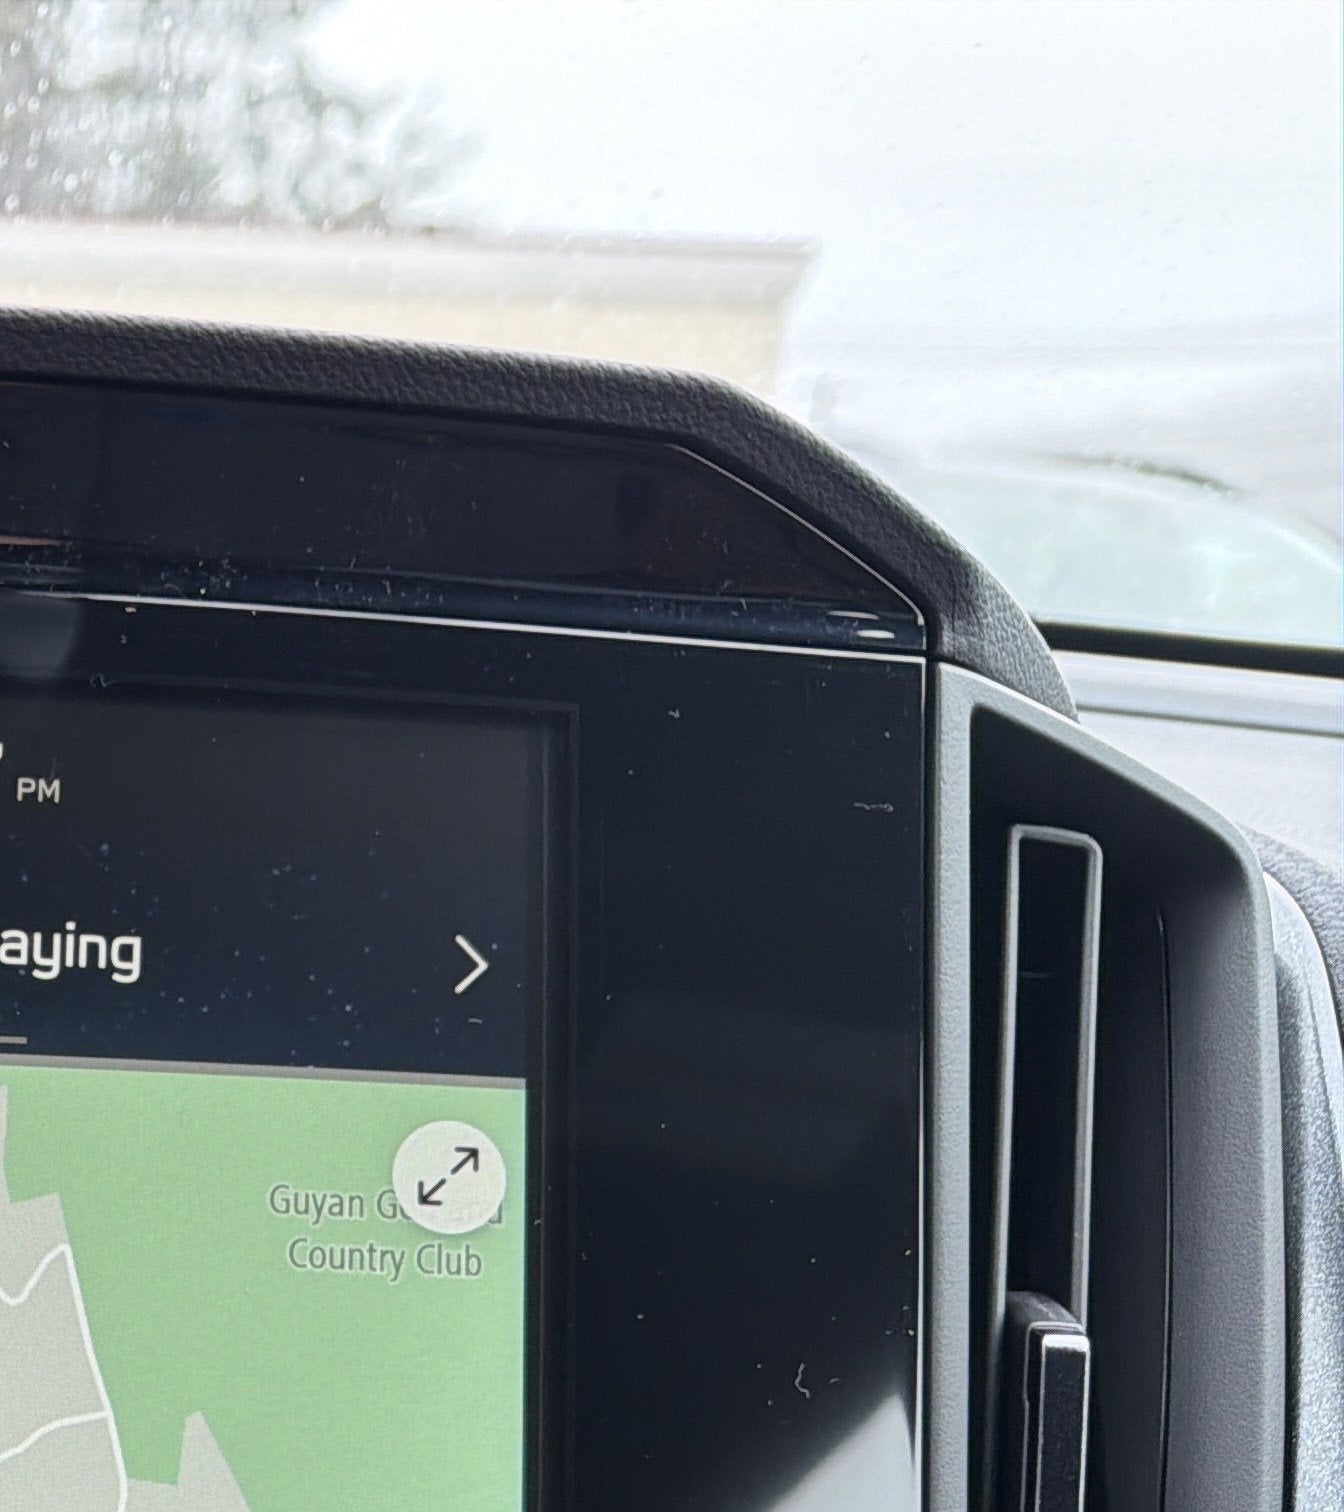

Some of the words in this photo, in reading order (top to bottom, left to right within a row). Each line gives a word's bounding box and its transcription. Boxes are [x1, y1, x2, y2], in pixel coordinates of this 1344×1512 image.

[17, 776, 61, 803] PM
[269, 1183, 364, 1225] Guyan
[288, 1237, 405, 1282] Country
[416, 1242, 482, 1277] Club
